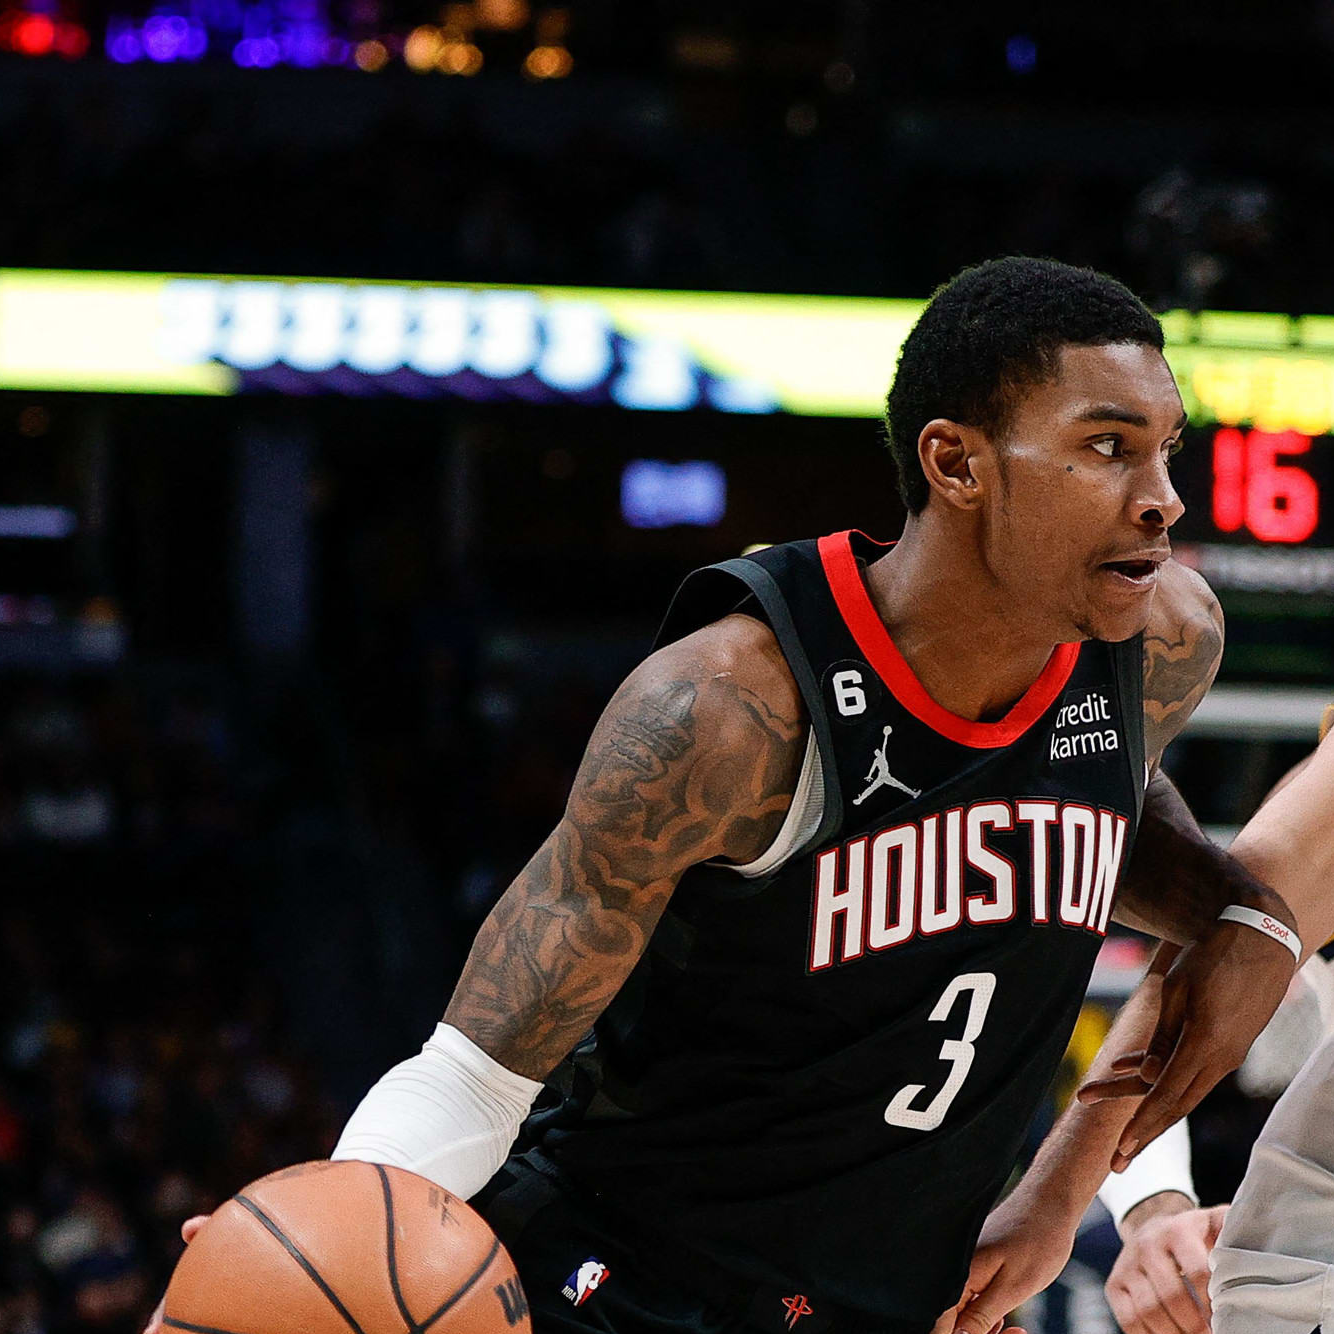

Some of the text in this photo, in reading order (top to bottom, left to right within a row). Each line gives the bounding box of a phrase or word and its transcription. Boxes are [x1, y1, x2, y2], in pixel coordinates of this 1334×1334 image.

[1212, 427, 1319, 543] 16
[832, 670, 867, 716] 6
[1055, 692, 1111, 729] credit
[1050, 729, 1119, 761] karma
[809, 799, 1129, 971] HOUSTON
[1261, 917, 1290, 941] Scoot
[884, 972, 996, 1130] 3
[561, 1284, 577, 1301] NBA
